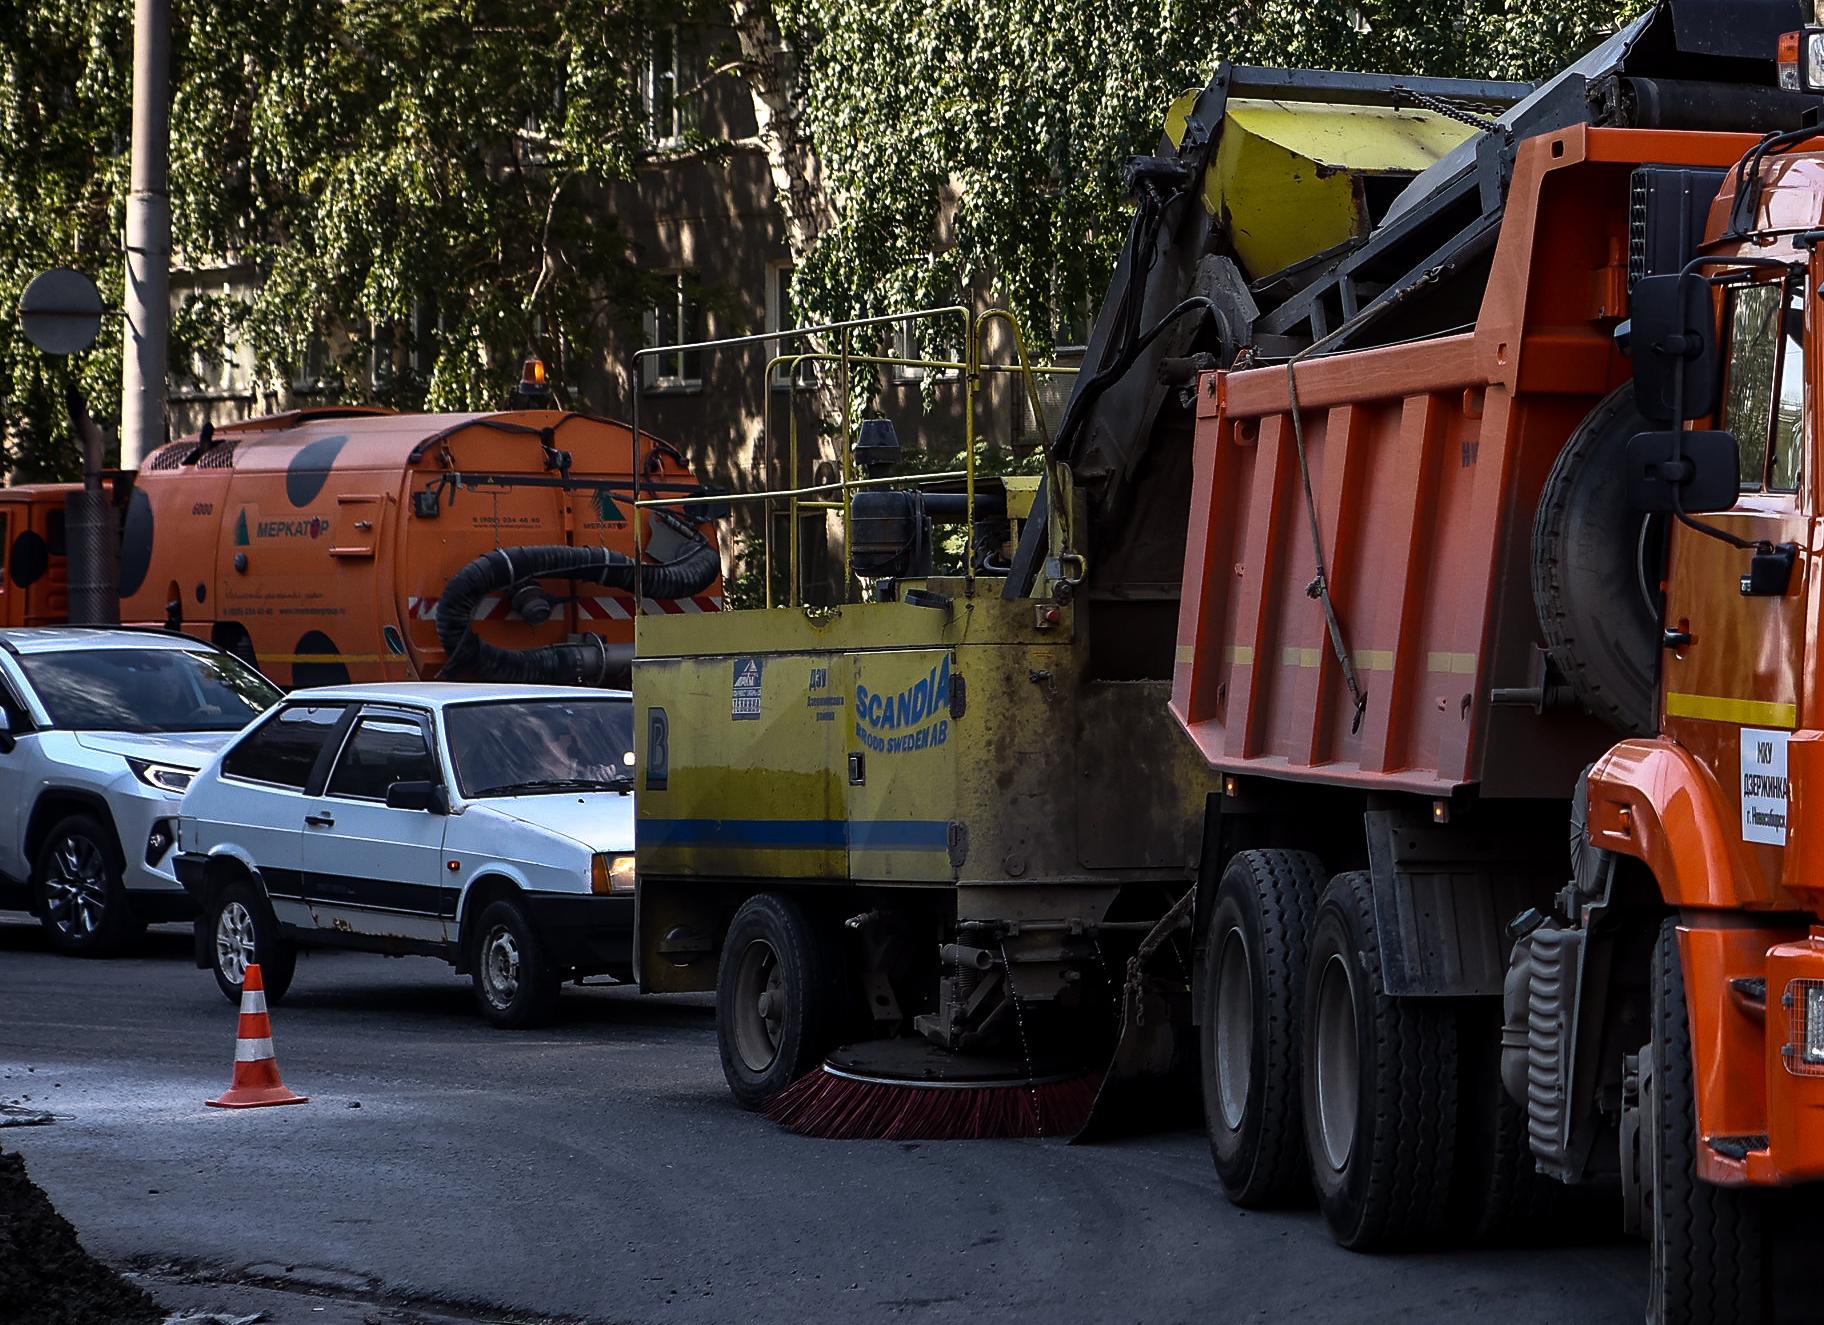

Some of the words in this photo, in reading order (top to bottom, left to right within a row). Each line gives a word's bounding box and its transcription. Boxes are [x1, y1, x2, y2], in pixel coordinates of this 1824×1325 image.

[256, 518, 329, 539] МЕРКАТОР
[855, 652, 951, 730] SCANDIA
[887, 726, 930, 754] SWEDEN
[929, 719, 948, 748] AB
[1756, 741, 1773, 765] МКУ
